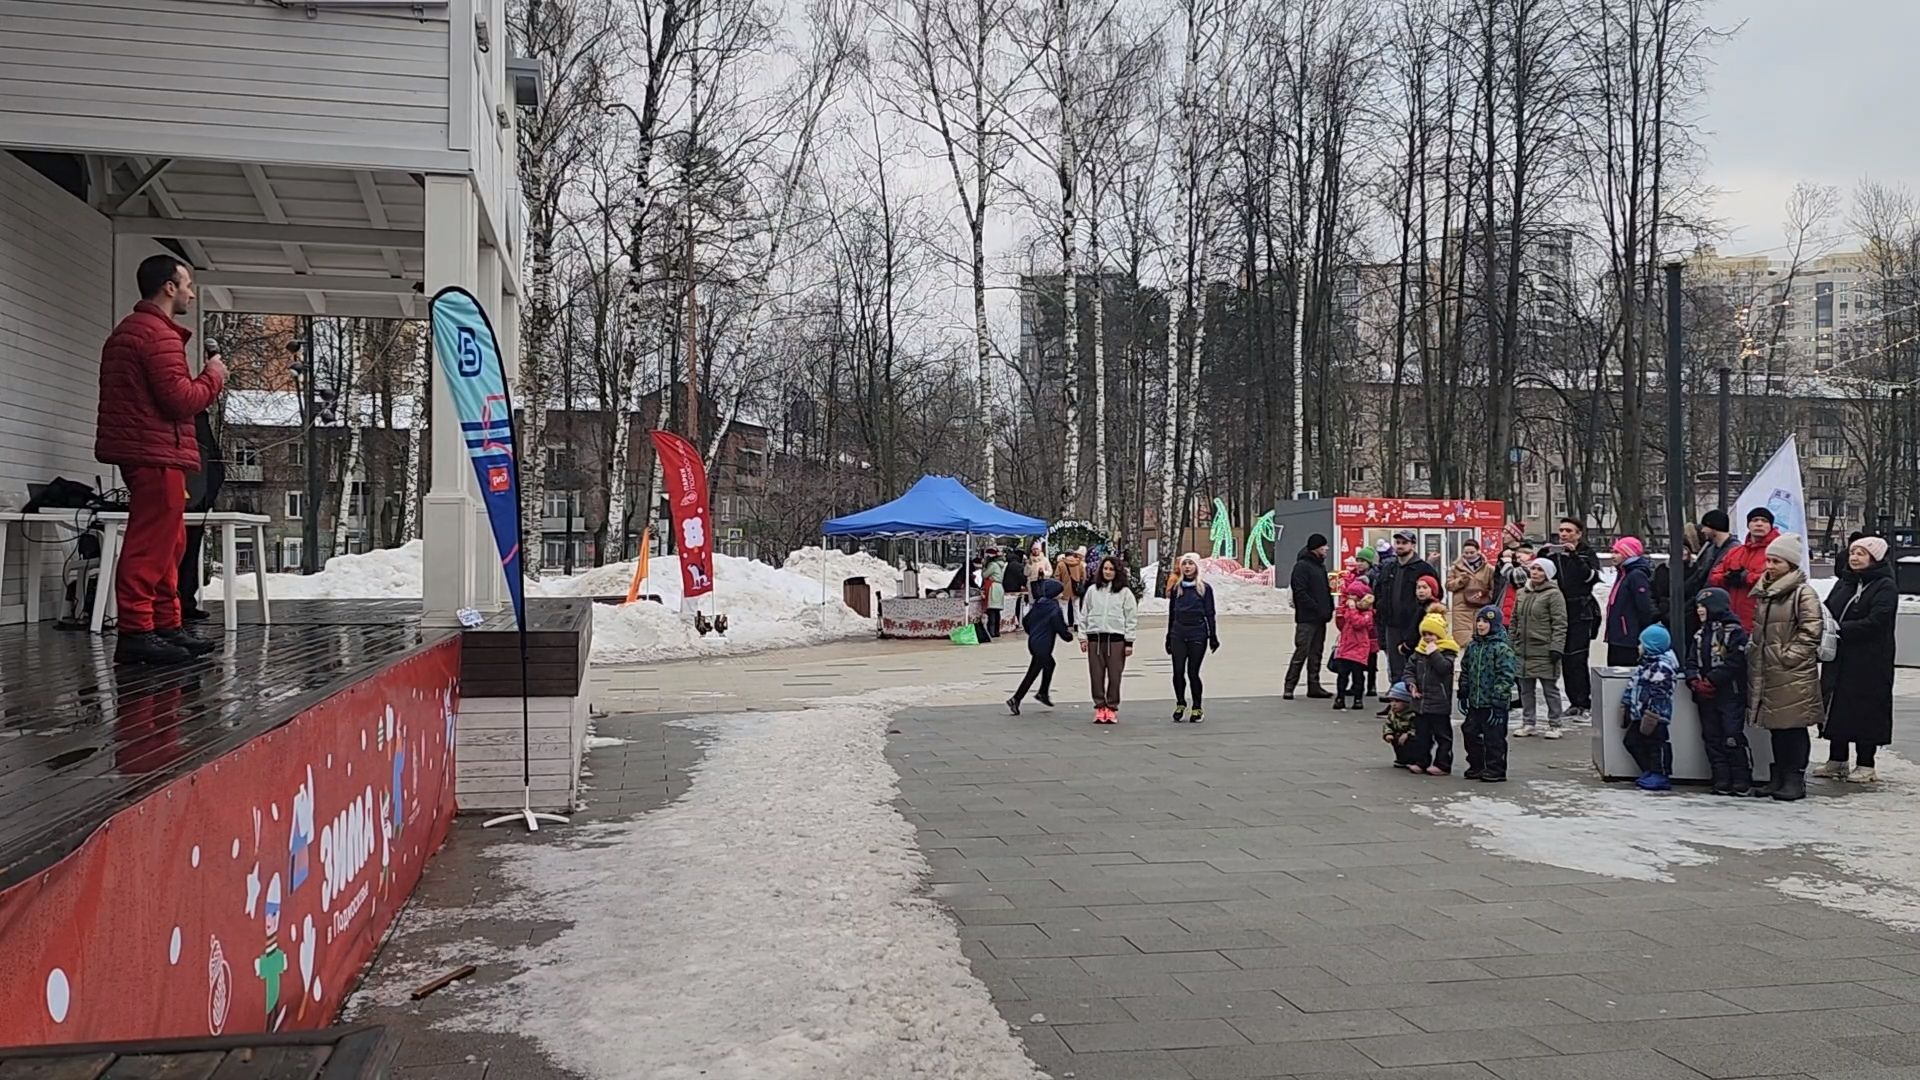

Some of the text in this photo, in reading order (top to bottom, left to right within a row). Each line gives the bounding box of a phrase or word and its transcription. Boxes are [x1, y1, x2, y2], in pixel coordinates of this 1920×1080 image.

[679, 468, 690, 491] ПАРКИ
[1337, 504, 1365, 514] ЗИМА
[320, 784, 375, 913] ЗИМА
